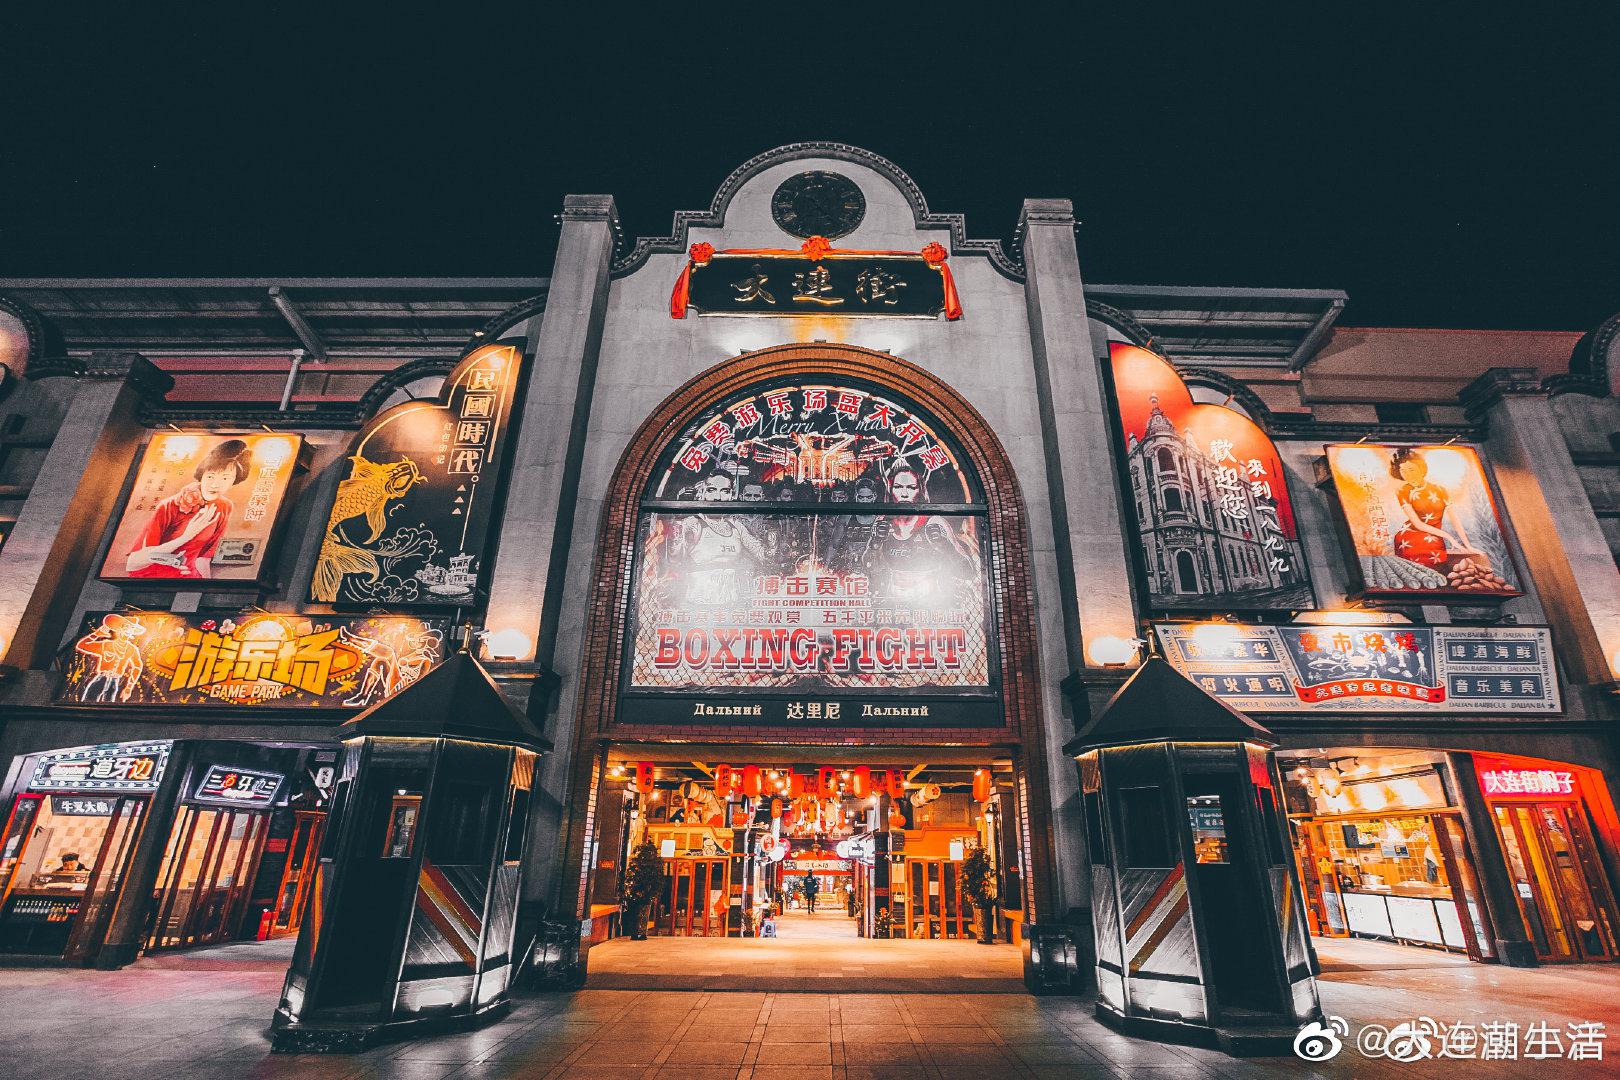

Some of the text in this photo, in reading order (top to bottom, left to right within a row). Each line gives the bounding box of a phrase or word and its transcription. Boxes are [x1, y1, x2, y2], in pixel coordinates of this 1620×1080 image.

[454, 371, 495, 472] 民國時代
[680, 389, 950, 474] 免费游乐场盛大开幕
[747, 413, 815, 436] Merry
[1210, 439, 1249, 519] 歡迎您
[1247, 459, 1290, 573] 來到一八九九
[756, 576, 870, 596] 搏击赛馆
[753, 599, 871, 607] FIGHT COMPETITION HALL
[655, 628, 966, 669] BOXING FIGHT
[1452, 645, 1531, 658] 啤酒海鲜
[169, 628, 340, 696] 游乐场
[210, 684, 284, 698] GAME PARK
[1201, 677, 1286, 692] 灯火通明
[1456, 680, 1535, 693] 音乐美食
[694, 703, 762, 717] Дальний
[786, 702, 841, 720] 达里尼
[861, 704, 929, 717] Дальний
[90, 757, 154, 780] 道牙边
